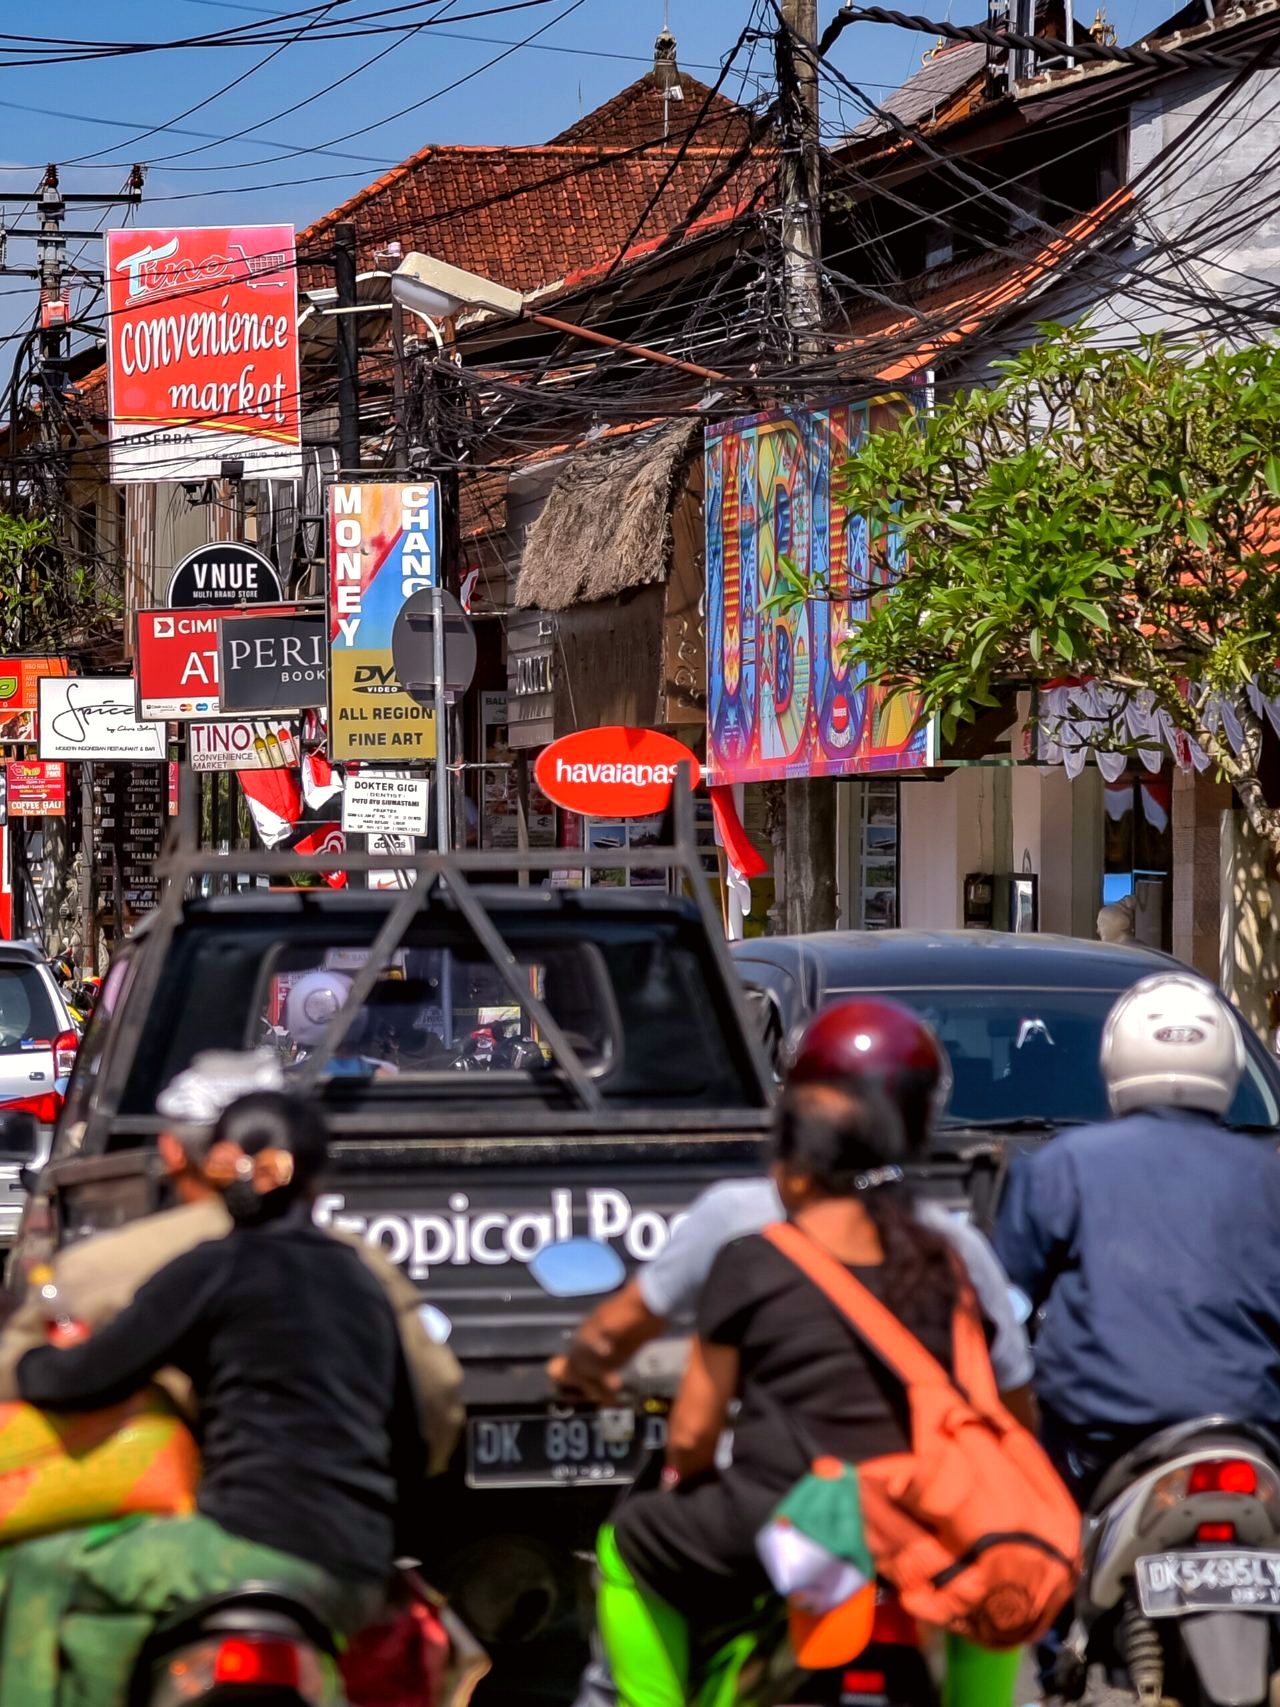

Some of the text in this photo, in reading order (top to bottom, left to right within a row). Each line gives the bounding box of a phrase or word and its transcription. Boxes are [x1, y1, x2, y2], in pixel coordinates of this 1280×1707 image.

[121, 294, 288, 375] convenience
[168, 364, 287, 425] market
[334, 486, 362, 647] MONEY
[193, 563, 258, 589] VNUE
[238, 590, 258, 598] STORE
[178, 619, 218, 634] CIM
[229, 636, 323, 670] PERI
[354, 666, 400, 683] DV
[339, 706, 433, 720] ALL REGION
[192, 725, 250, 752] TINO
[349, 732, 423, 746] FINE ART
[193, 753, 253, 761] CONVENIENCE
[193, 761, 227, 770] MARKET
[556, 758, 679, 787] havaianas
[354, 781, 418, 792] DOKTER GIGI
[11, 801, 40, 810] COFFEE
[374, 841, 406, 849] adas
[586, 1188, 691, 1262] Po
[475, 1421, 523, 1464] DK
